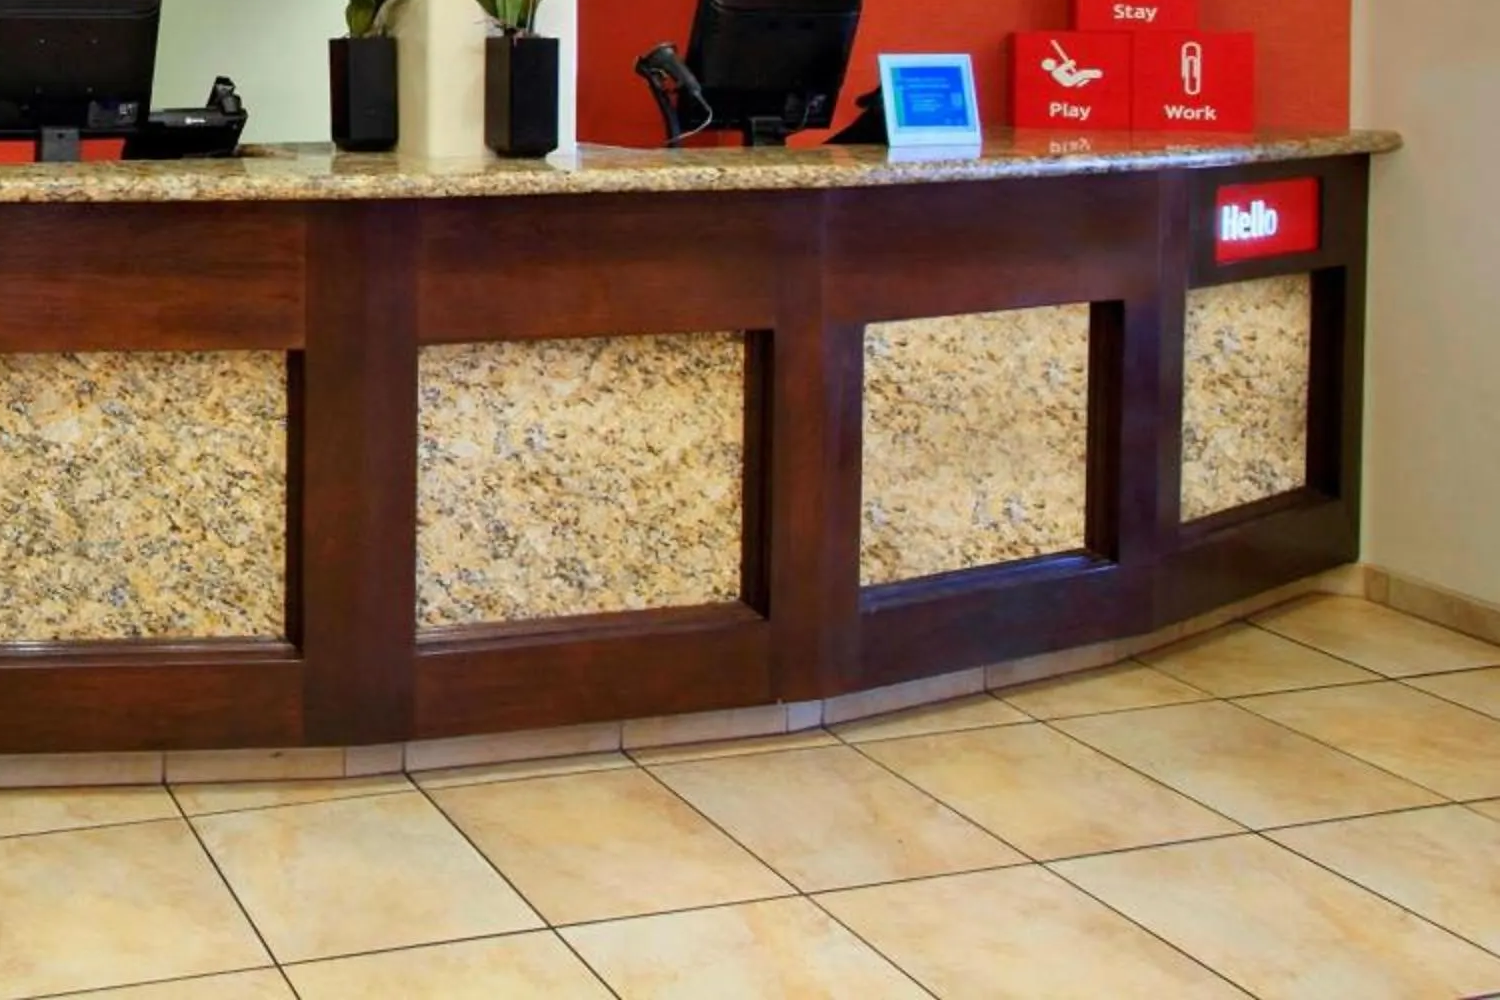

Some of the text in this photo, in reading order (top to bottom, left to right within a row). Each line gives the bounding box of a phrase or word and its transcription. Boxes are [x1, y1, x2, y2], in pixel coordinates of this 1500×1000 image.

[1113, 4, 1158, 22] Stay
[1049, 102, 1091, 119] Play
[1164, 105, 1216, 121] Work
[1222, 199, 1279, 241] Hello
